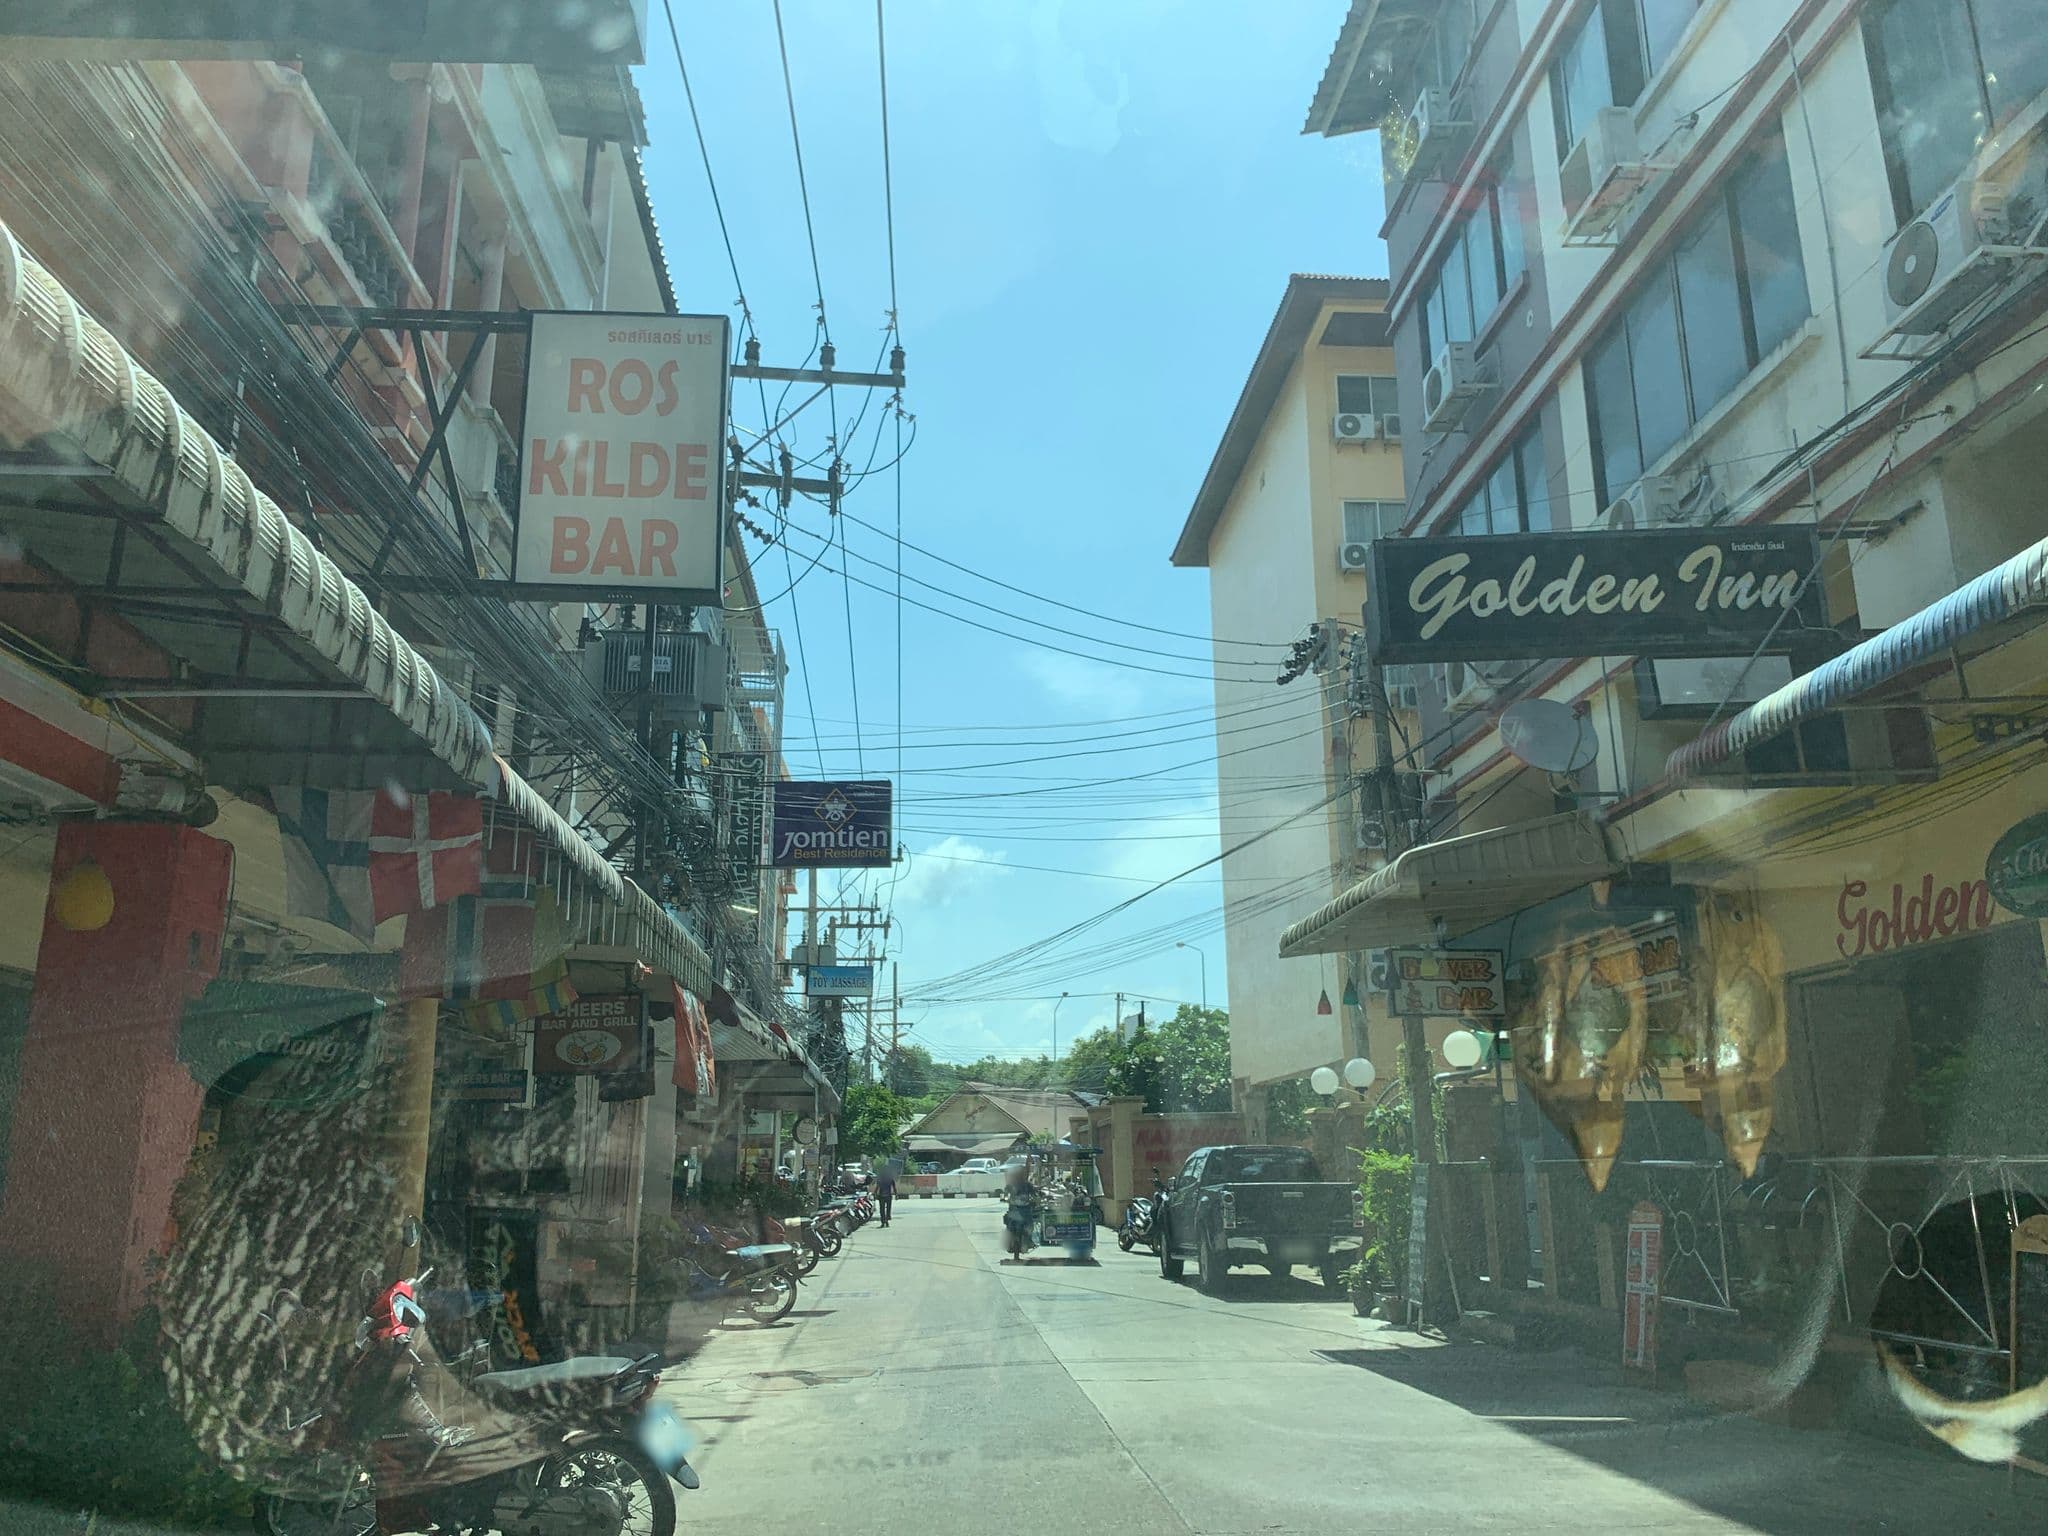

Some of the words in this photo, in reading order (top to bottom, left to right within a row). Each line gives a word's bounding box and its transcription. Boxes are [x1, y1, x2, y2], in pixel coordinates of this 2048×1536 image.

[567, 358, 680, 416] ROS
[529, 438, 708, 500] KILDE
[549, 516, 679, 577] BAR
[1408, 552, 1666, 640] Golden
[1678, 544, 1801, 611] Inn
[793, 848, 821, 860] Best
[824, 848, 887, 859] Residence
[1836, 873, 1996, 958] Golden
[813, 977, 828, 988] TOY
[830, 977, 868, 988] MASSAGE
[541, 1020, 568, 1030] BAR
[571, 1018, 599, 1029] AND
[603, 1016, 638, 1027] GRILL
